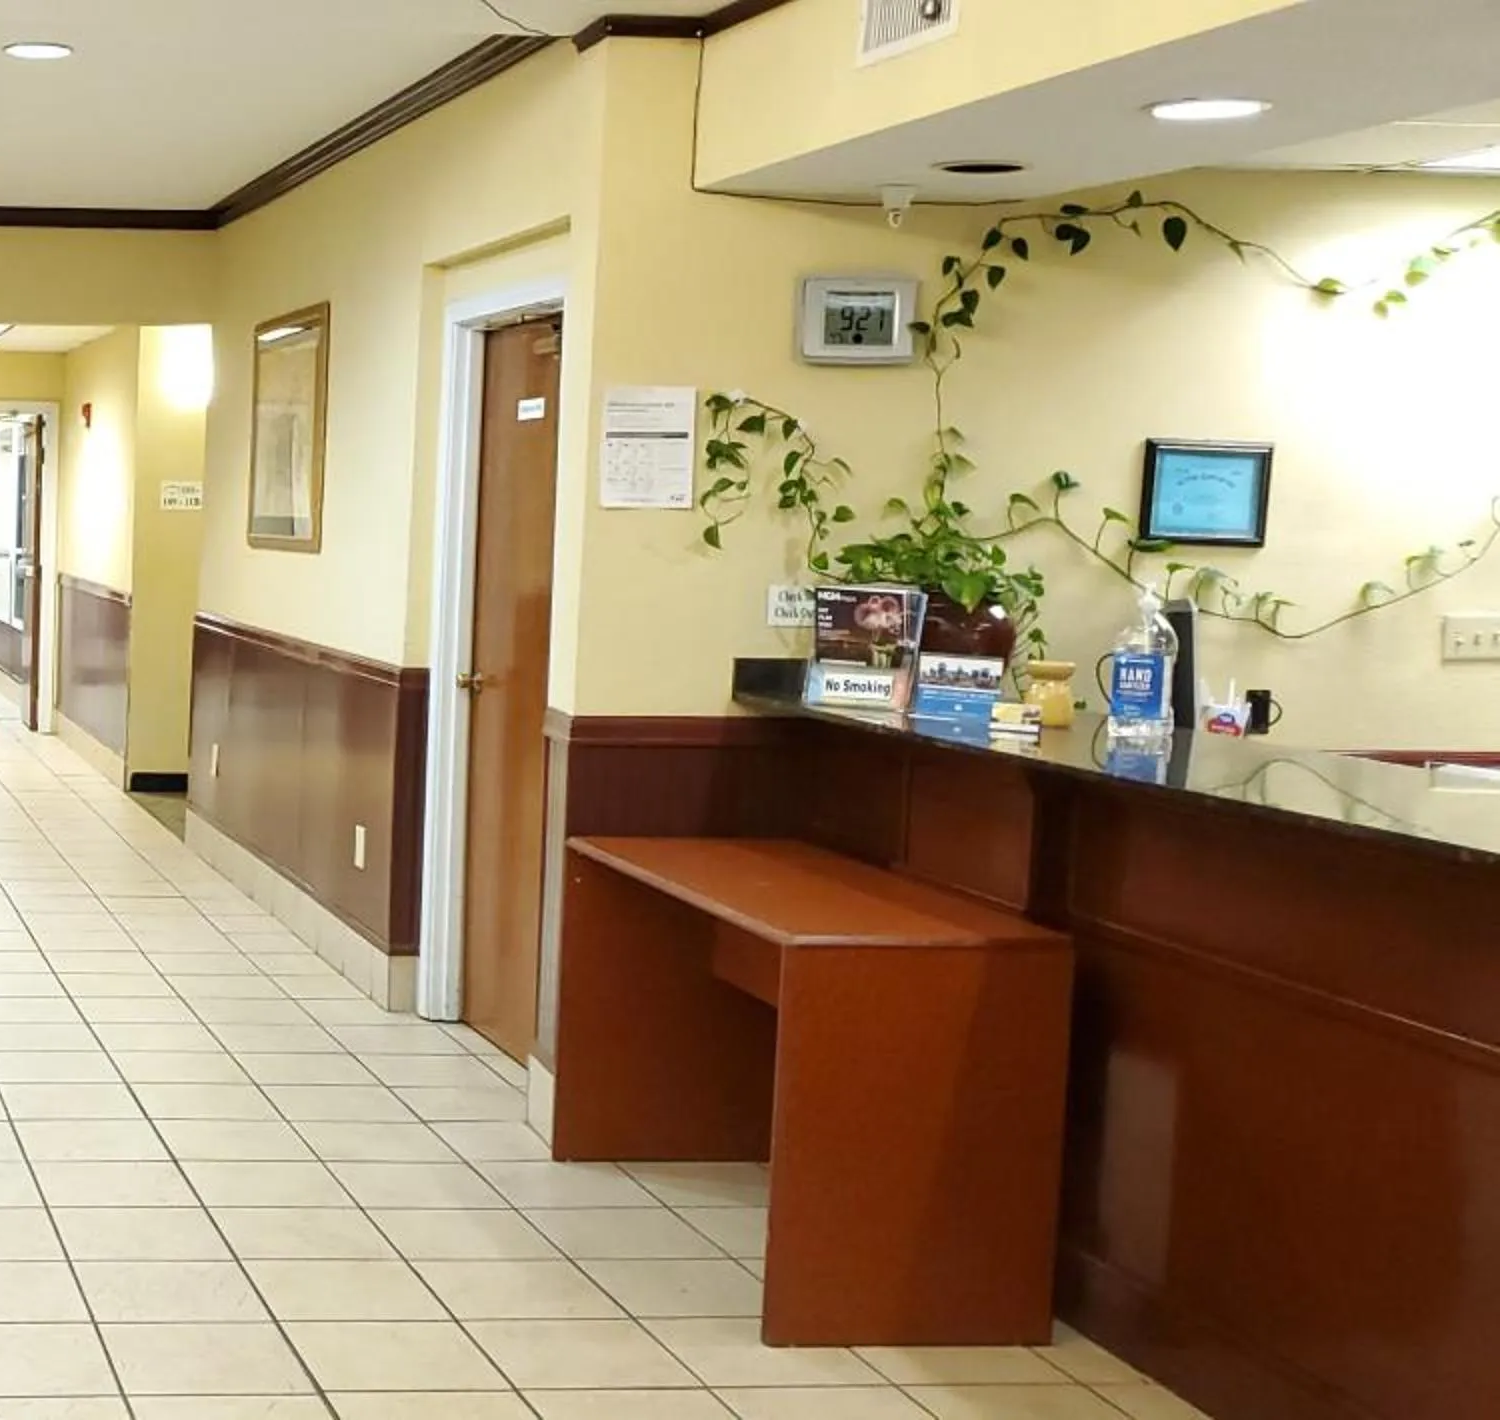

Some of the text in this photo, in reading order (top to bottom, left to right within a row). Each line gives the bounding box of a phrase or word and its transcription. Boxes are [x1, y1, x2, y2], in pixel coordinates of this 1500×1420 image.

[1119, 667, 1153, 682] HAND
[825, 678, 891, 697] No Smoking
